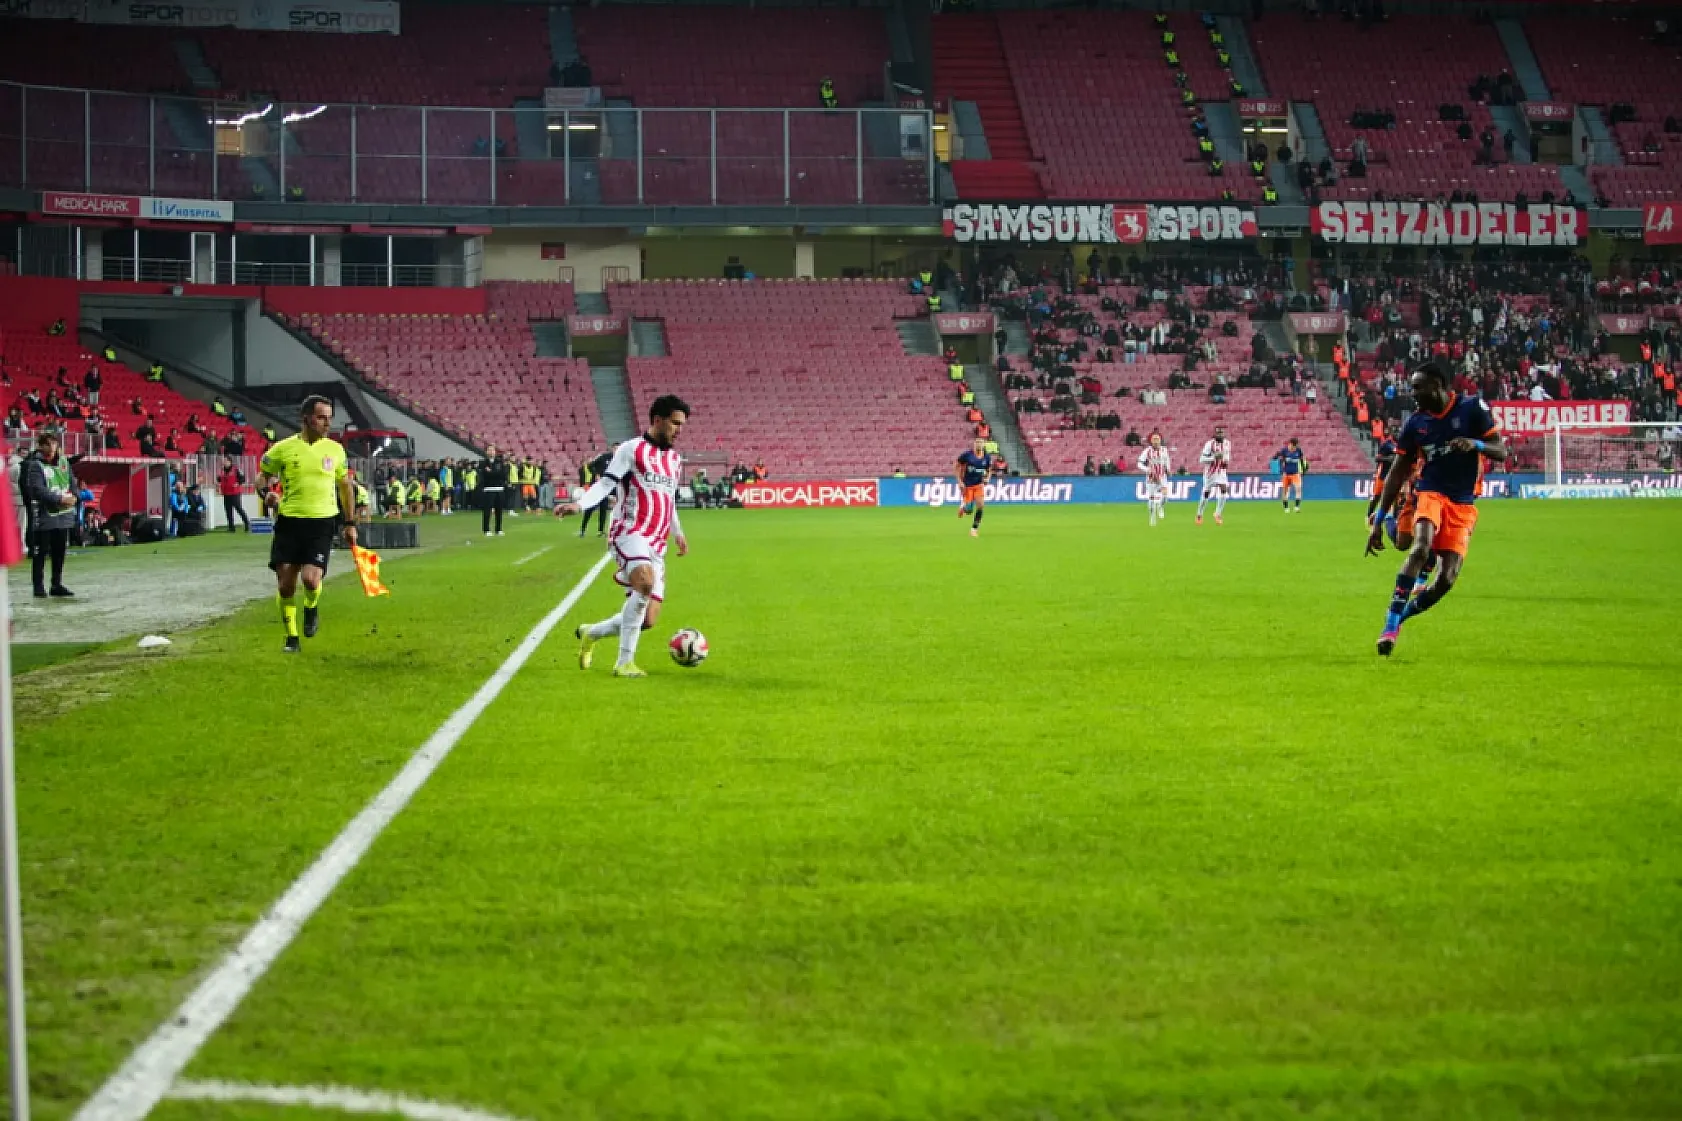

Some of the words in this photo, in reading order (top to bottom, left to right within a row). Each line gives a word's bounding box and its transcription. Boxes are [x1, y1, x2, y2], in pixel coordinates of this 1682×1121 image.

[954, 204, 1101, 243] SAMSUN
[1158, 205, 1244, 242] SPOR
[1320, 201, 1578, 246] SEHZADELER
[1492, 403, 1628, 431] SEHZADELER
[914, 476, 962, 506] uğu
[1135, 479, 1197, 500] uur
